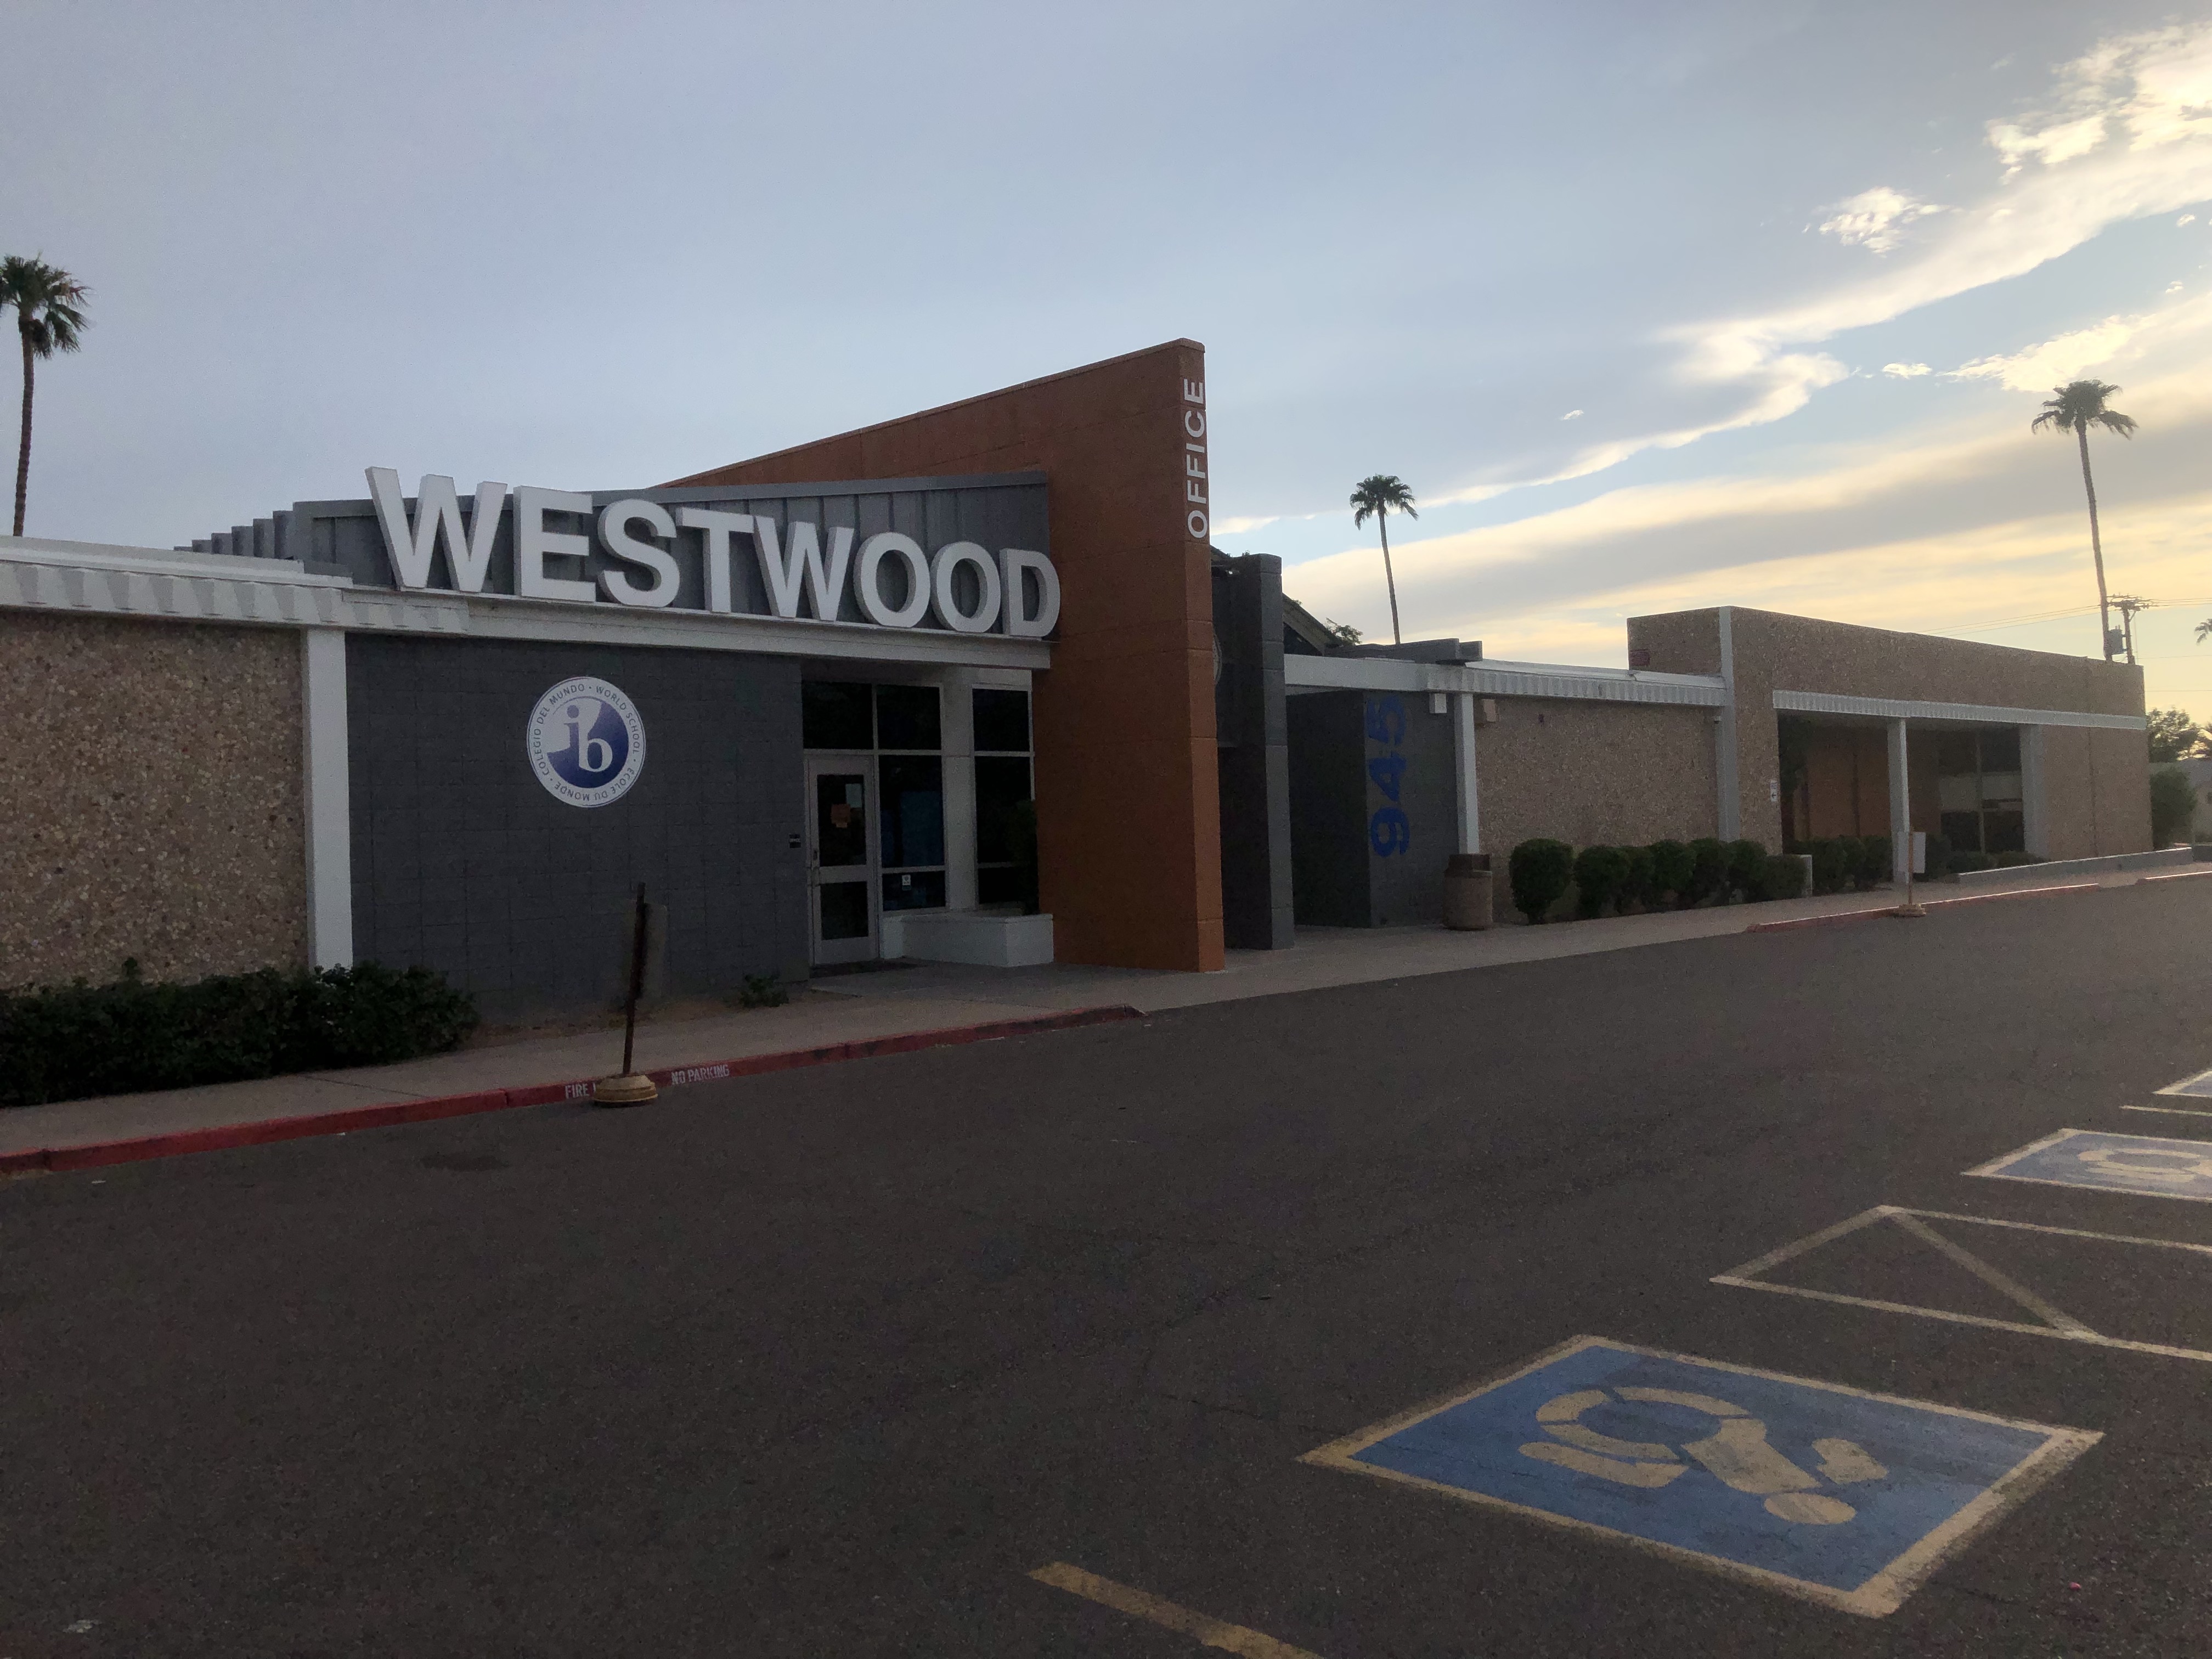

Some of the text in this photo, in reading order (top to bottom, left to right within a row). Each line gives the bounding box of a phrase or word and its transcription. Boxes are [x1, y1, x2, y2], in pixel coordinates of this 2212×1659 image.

[1183, 379, 1207, 538] OFFICE
[365, 466, 1061, 638] WESTWOOD
[534, 684, 585, 776] COLEGIO DEL MUNDO
[596, 686, 640, 753] WORLD SCHOOL
[555, 781, 590, 802] MONDE
[594, 791, 608, 801] DU
[1367, 695, 1410, 857] 945
[565, 1083, 590, 1099] FIRE
[670, 1064, 730, 1086] NO PARKING
